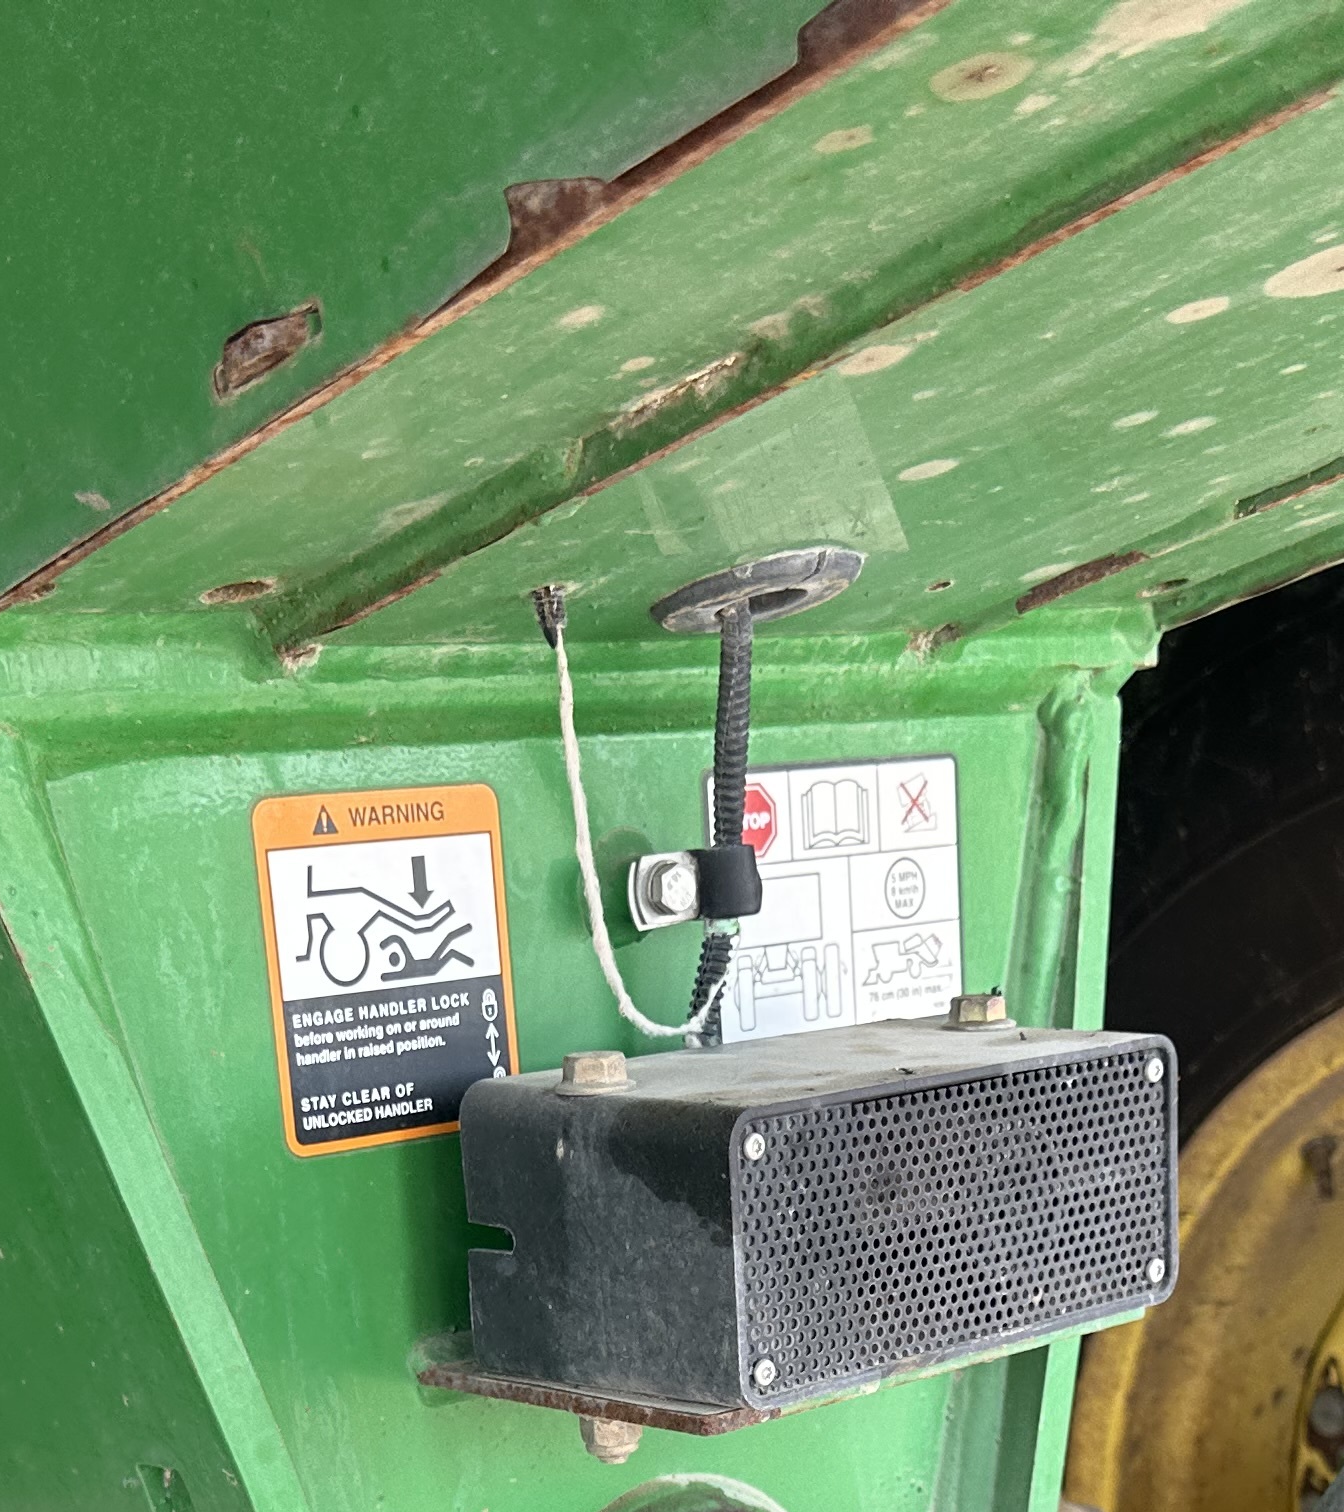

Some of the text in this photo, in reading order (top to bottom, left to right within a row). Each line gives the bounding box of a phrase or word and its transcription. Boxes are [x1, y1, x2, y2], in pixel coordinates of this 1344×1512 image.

[348, 801, 445, 827] WARNING
[742, 811, 771, 831] TOP
[898, 871, 918, 882] MPH
[894, 898, 914, 909] MAX
[881, 991, 895, 1001] cm
[292, 992, 470, 1029] ENGAGE HANDLER LOCK
[294, 1012, 460, 1048] before working on or around
[296, 1034, 446, 1066] handler in raised position.
[301, 1082, 415, 1112] STAY CLEAR OF
[302, 1097, 433, 1131] UNLOCKED HANDLER
